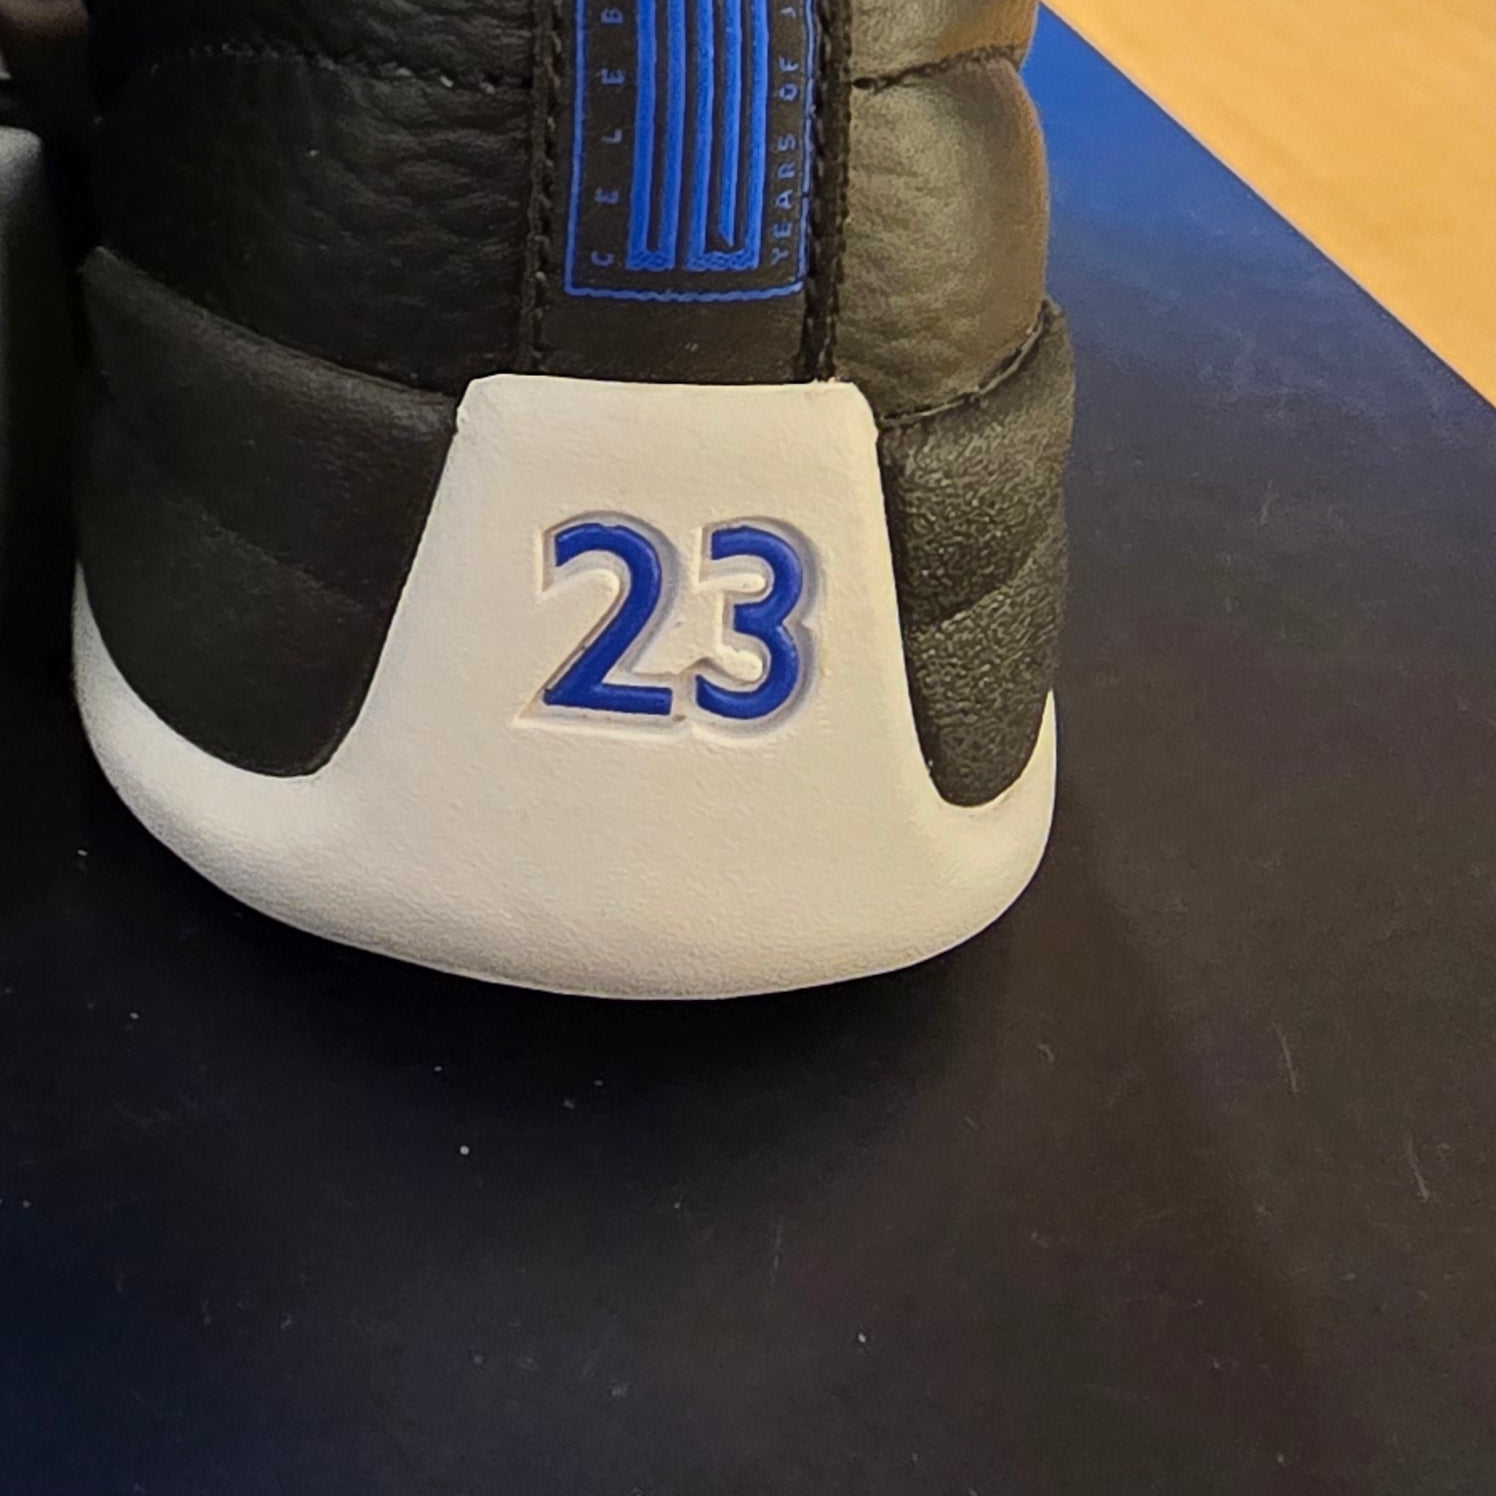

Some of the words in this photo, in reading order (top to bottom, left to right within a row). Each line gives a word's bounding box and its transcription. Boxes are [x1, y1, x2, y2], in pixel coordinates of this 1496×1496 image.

[776, 57, 799, 101] OF
[771, 133, 797, 265] YEARS
[518, 511, 817, 739] 23
